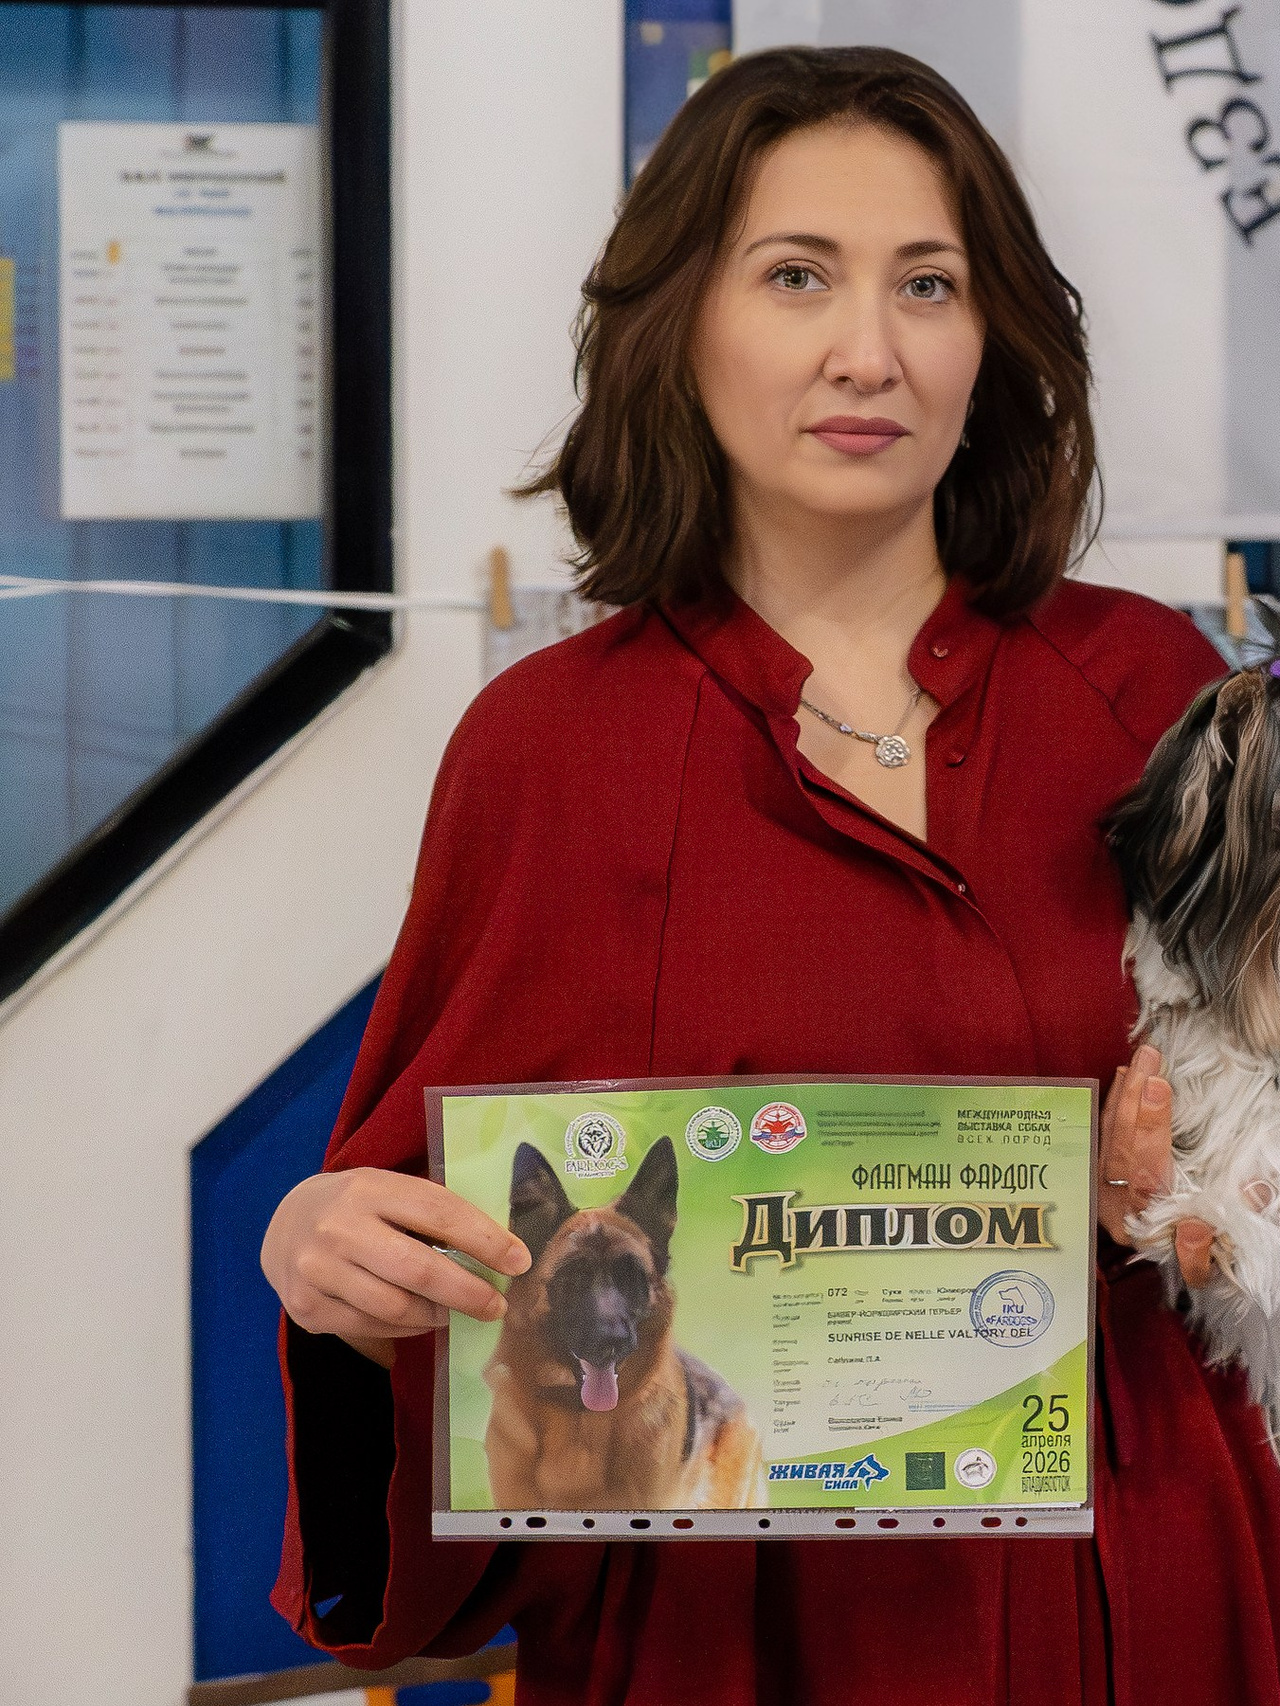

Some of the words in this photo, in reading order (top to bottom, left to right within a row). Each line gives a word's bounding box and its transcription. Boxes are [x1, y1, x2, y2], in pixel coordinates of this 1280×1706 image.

[957, 1109, 1051, 1121] МЕЖДУНАРОДНАЯ
[957, 1122, 1012, 1132] ВЫСТАВКА
[1018, 1122, 1051, 1132] СОБАК
[957, 1135, 993, 1144] ВСЕХ
[1003, 1134, 1051, 1145] ПОРОД
[852, 1164, 951, 1190] ФЛАГМАН
[960, 1164, 1049, 1194] ФАРДОГС
[1002, 1304, 1024, 1314] IKU
[828, 1332, 881, 1342] SUNRISE
[885, 1331, 901, 1341] DE
[905, 1330, 945, 1340] NELLE
[948, 1328, 1006, 1339] VALTORY
[1010, 1328, 1034, 1338] DEL
[1022, 1394, 1069, 1432] 25
[1021, 1434, 1071, 1451] апреля
[1022, 1451, 1070, 1473] 2026
[769, 1463, 846, 1480] ЖИВАЯ
[824, 1480, 858, 1490] СИЛА
